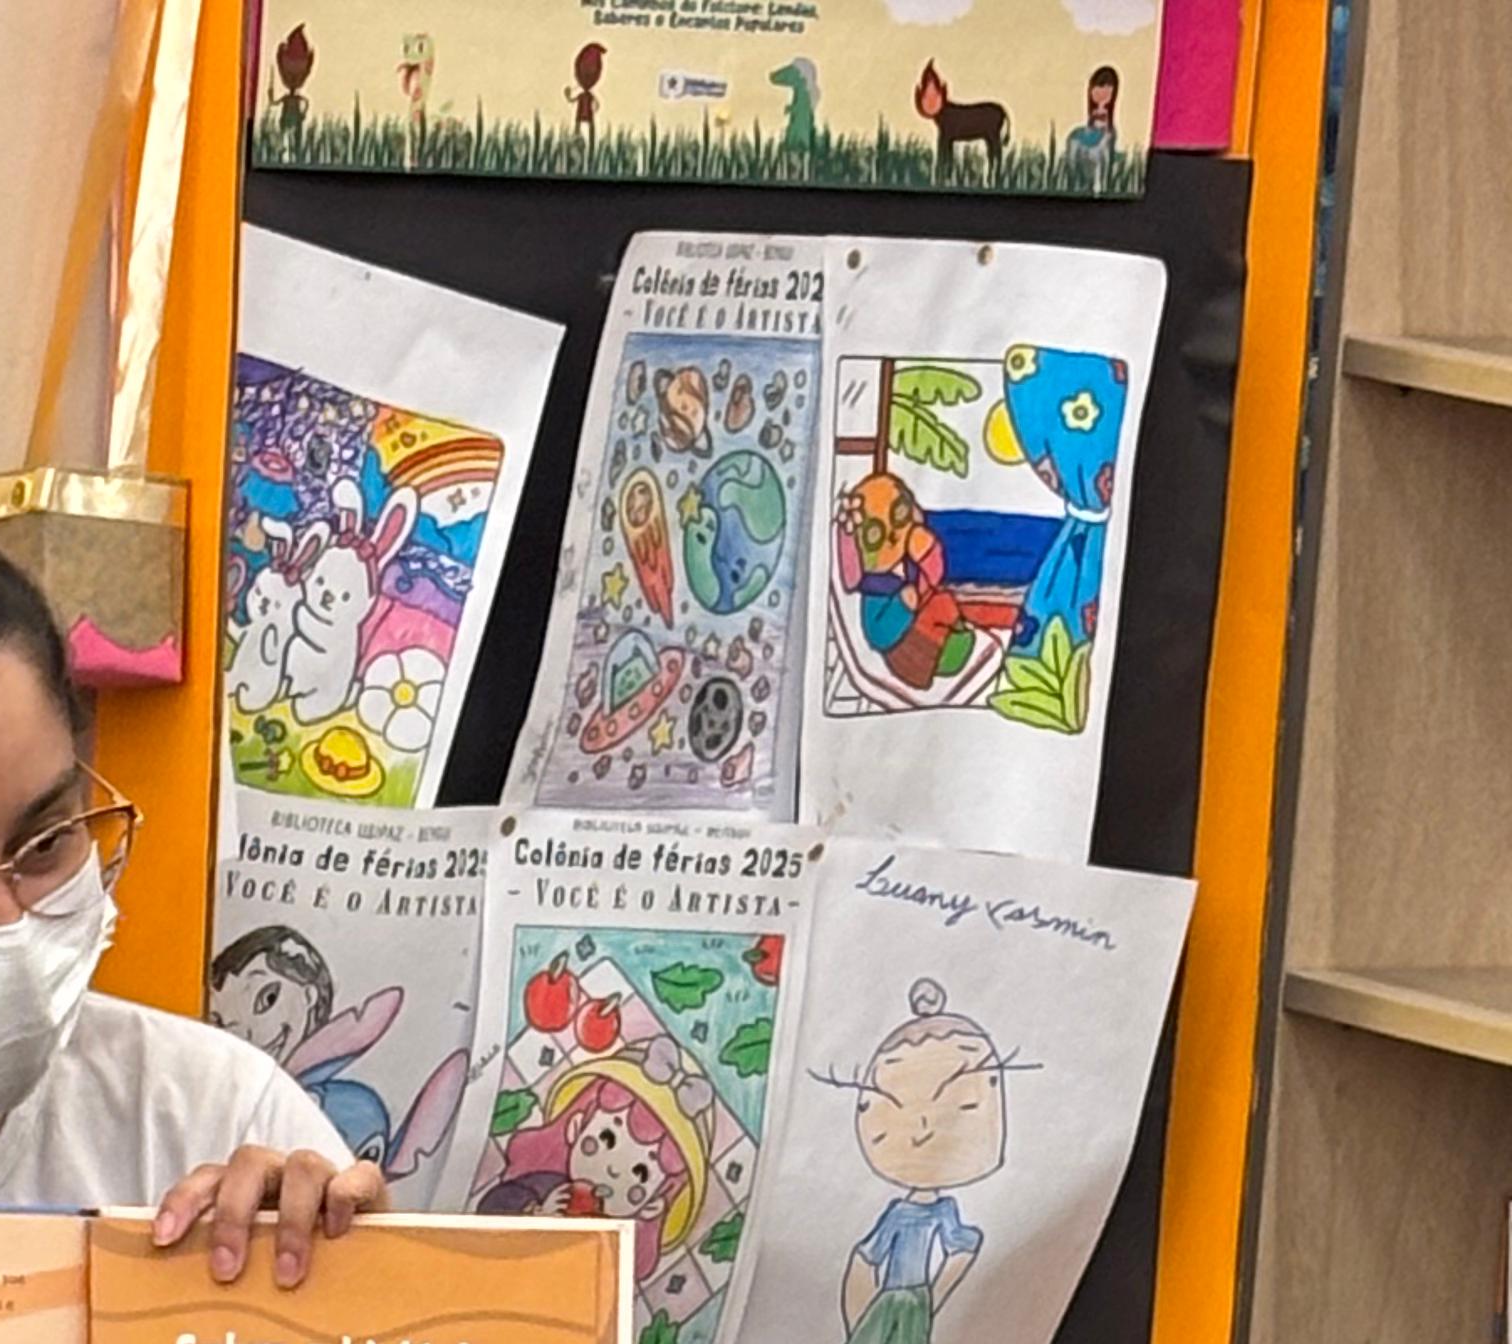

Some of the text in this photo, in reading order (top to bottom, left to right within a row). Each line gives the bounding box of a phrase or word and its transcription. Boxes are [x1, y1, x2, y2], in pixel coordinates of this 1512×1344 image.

[594, 10, 650, 27] Saberes
[735, 16, 804, 34] Populares
[632, 265, 695, 296] Colônia
[726, 266, 780, 298] férias
[271, 811, 352, 835] BIBLIOTECA
[316, 846, 350, 872] de
[362, 848, 437, 879] férias
[514, 838, 804, 878] Colônia de férias 2025
[226, 870, 297, 904] VOCÊ
[376, 888, 479, 917] ARTISTA
[536, 877, 599, 908] VOCÊ
